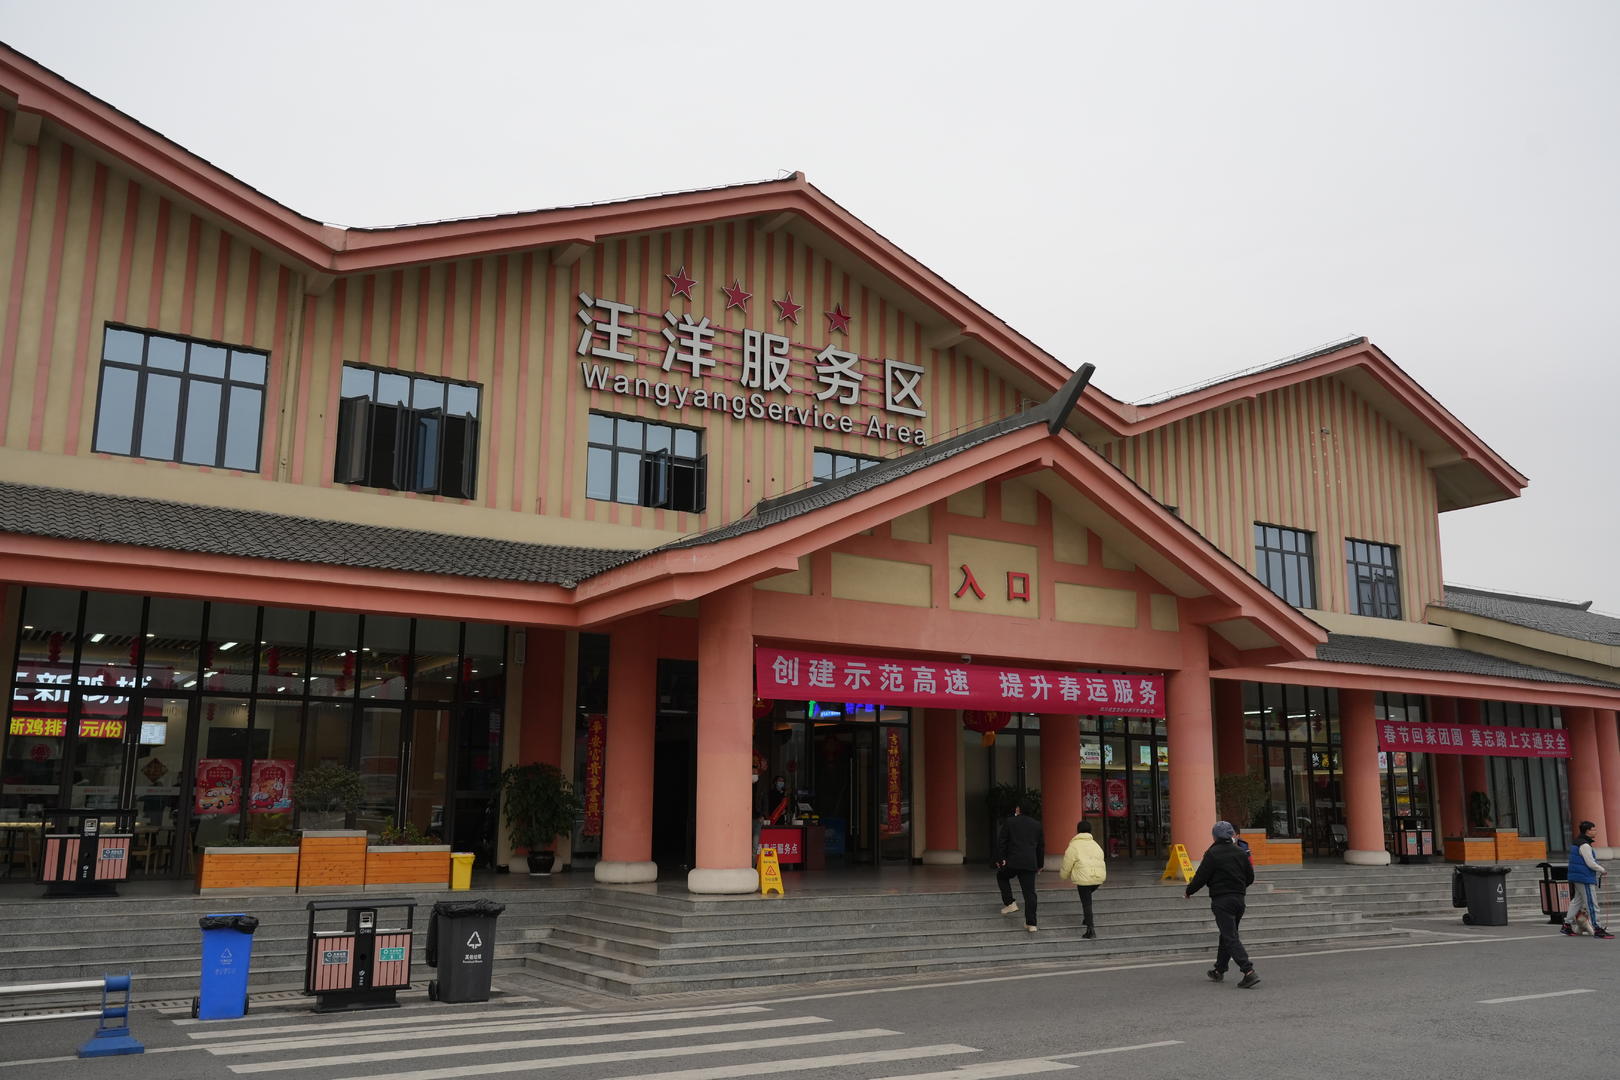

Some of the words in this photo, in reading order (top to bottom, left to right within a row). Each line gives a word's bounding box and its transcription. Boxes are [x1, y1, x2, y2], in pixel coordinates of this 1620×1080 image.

[577, 291, 927, 418] 汪洋服务区
[866, 415, 927, 447] Area
[954, 564, 1030, 602] 入口
[772, 655, 970, 696] 创建示范高速
[999, 671, 1157, 705] 提升春运服务
[1384, 725, 1464, 746] 春节回家团圆
[1470, 729, 1566, 750] 莫忘路上交通安全
